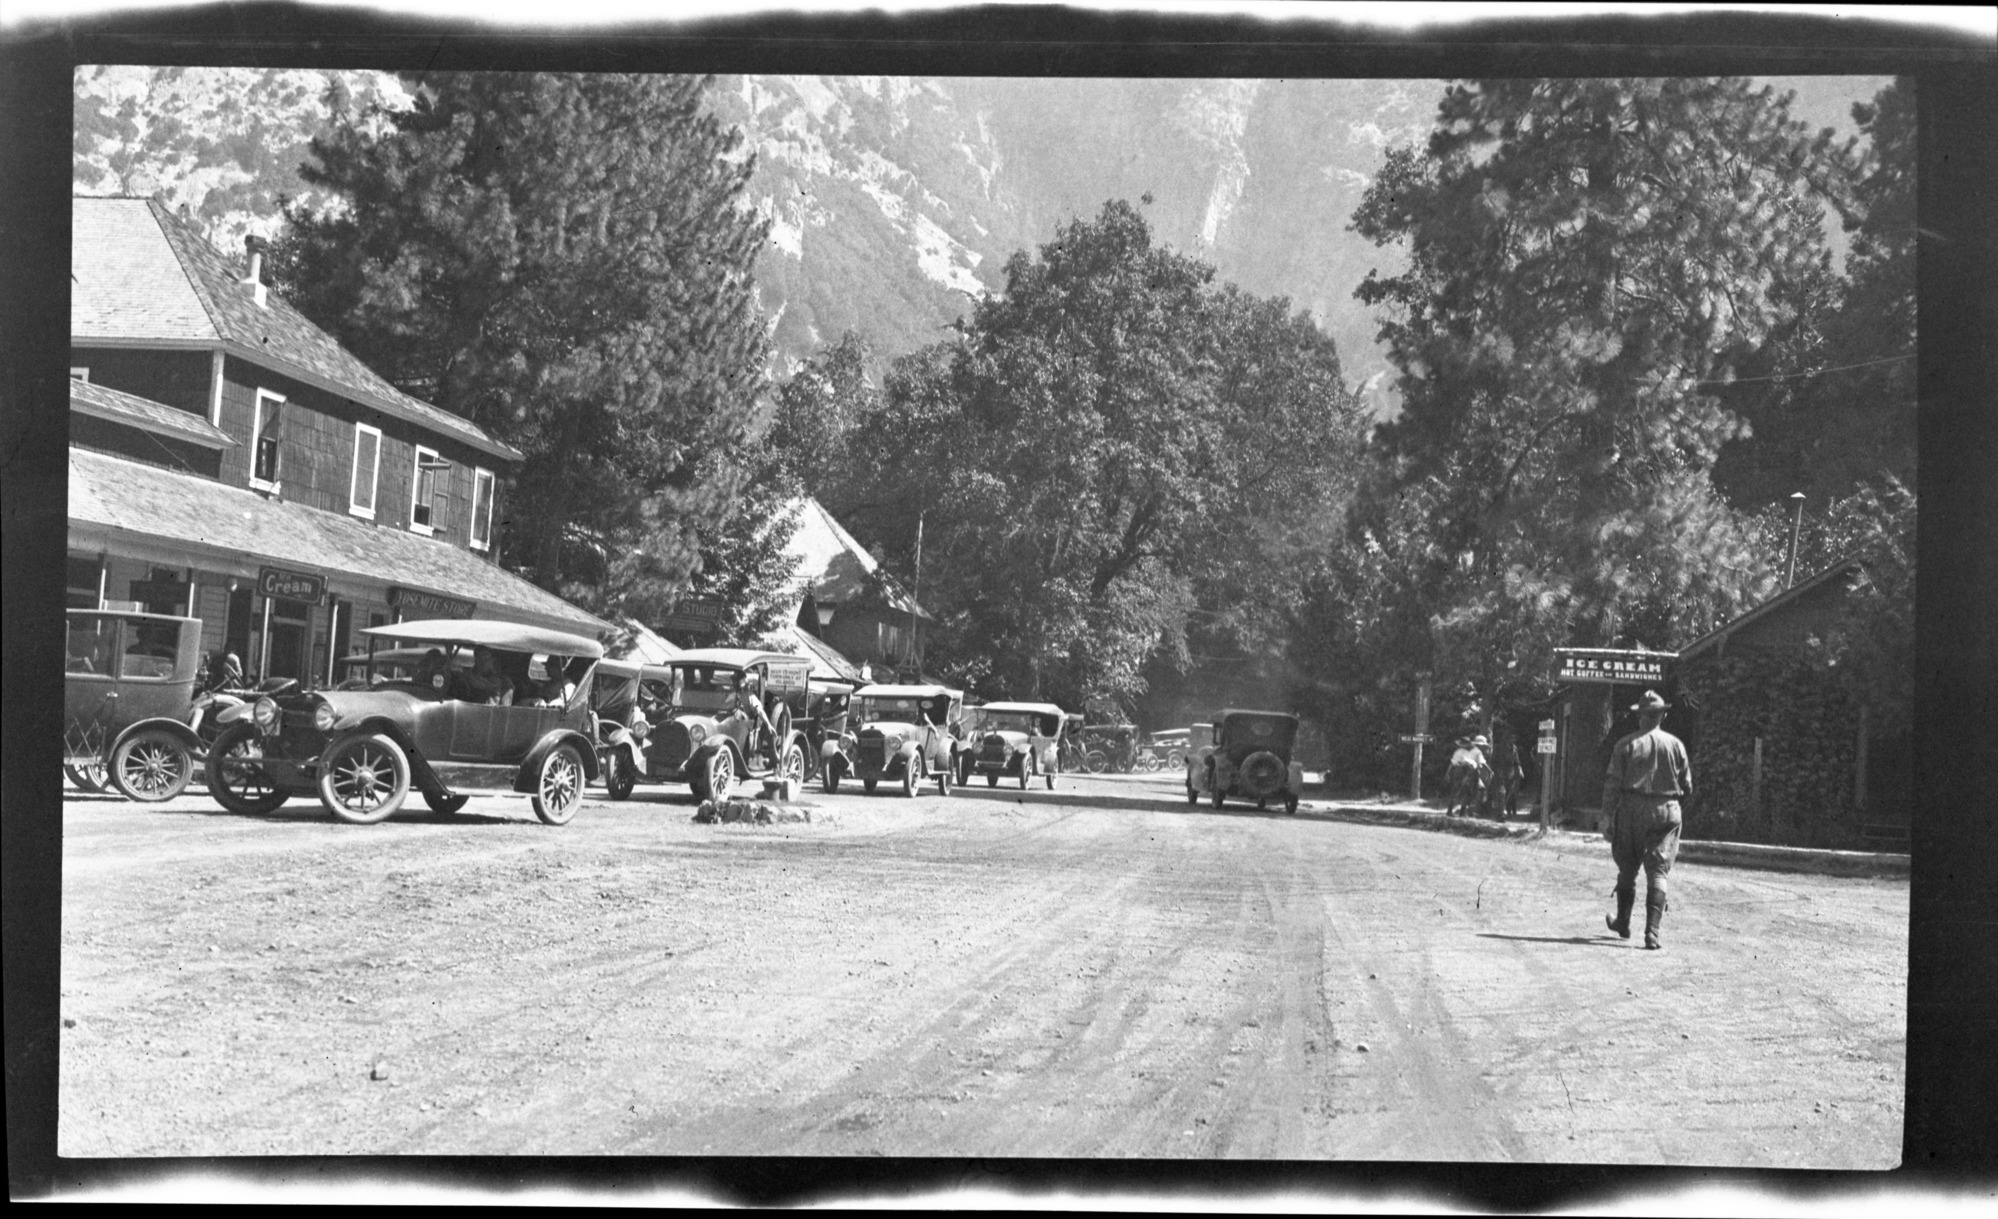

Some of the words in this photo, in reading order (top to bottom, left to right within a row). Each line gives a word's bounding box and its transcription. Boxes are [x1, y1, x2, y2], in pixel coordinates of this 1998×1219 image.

[266, 574, 312, 594] Cream
[398, 591, 442, 610] YOSEMITE
[443, 601, 472, 616] STORE
[683, 601, 717, 617] STUDIO
[1560, 668, 1574, 677] HOT
[1576, 669, 1604, 678] COFFEE
[1566, 658, 1598, 669] ICE
[1602, 661, 1661, 673] CREAM
